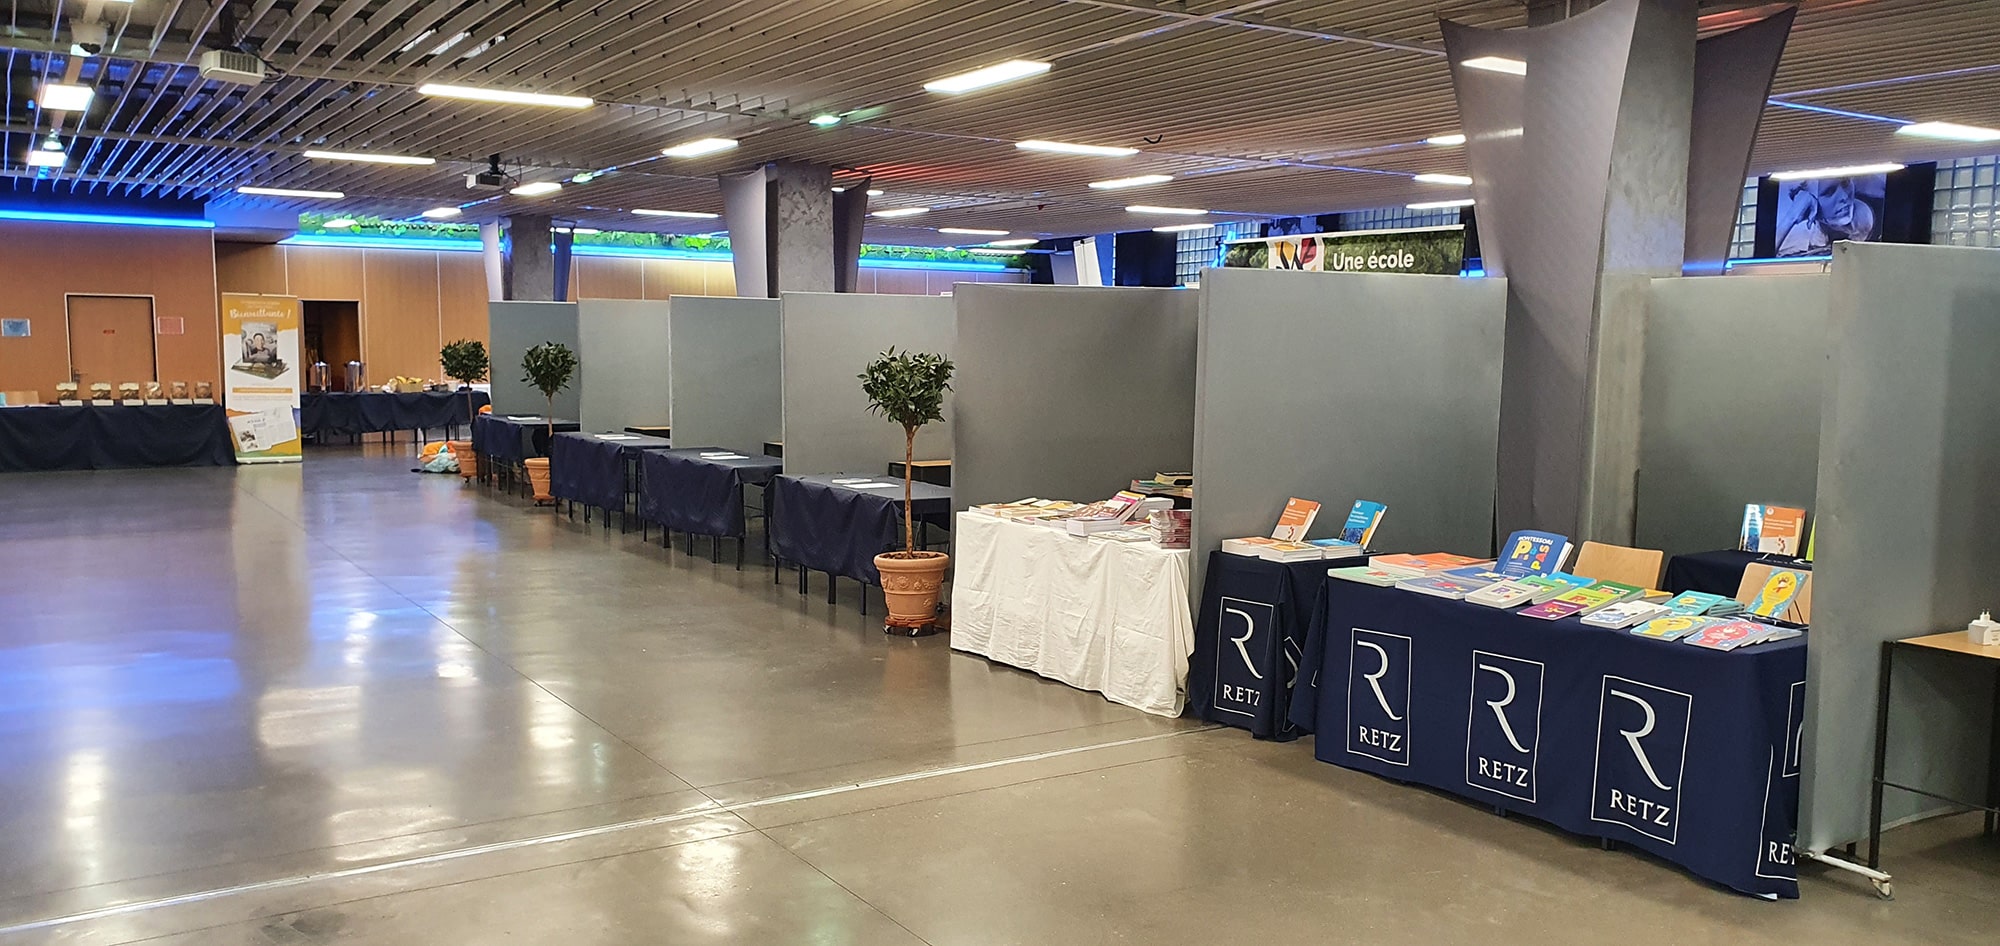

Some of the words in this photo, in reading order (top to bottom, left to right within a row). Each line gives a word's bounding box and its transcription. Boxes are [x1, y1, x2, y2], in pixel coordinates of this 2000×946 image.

[1333, 252, 1364, 270] Une
[1367, 249, 1414, 269] école
[1359, 726, 1402, 752] RETZ
[1479, 757, 1528, 787] RETZ
[1610, 789, 1670, 827] RETZ
